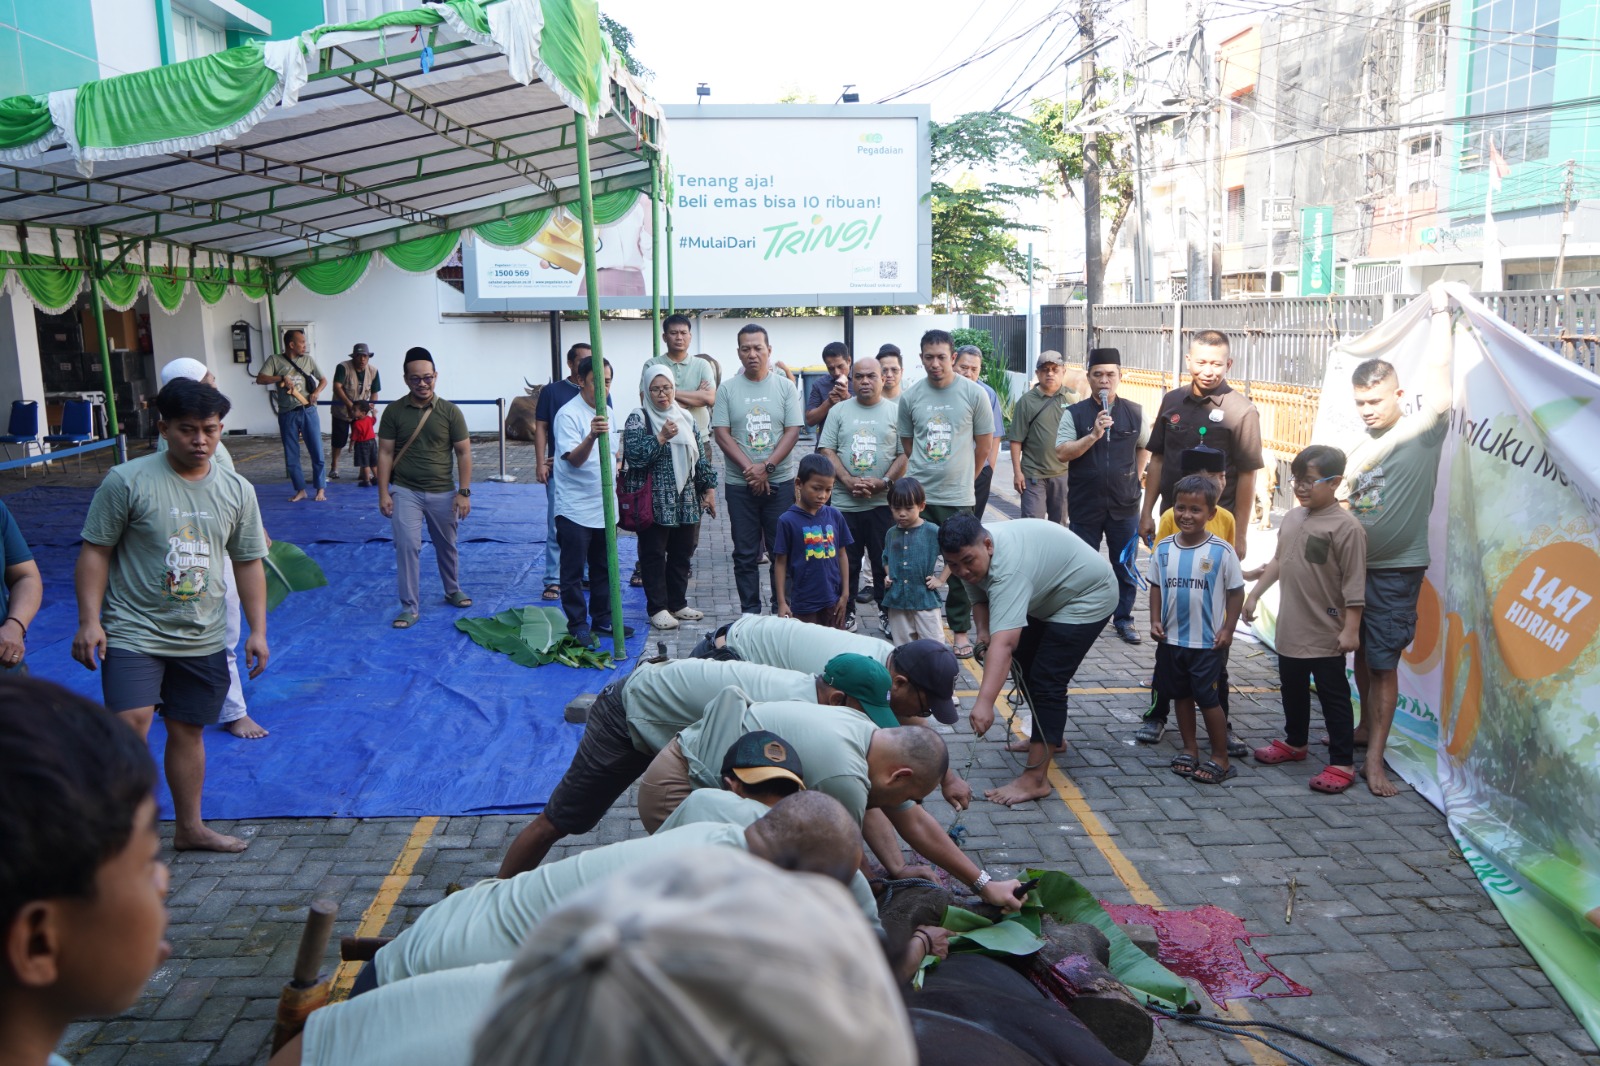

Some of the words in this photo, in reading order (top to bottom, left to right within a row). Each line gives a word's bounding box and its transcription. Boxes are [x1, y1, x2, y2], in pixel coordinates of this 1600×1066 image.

[857, 145, 904, 155] Pegadaian
[677, 174, 738, 193] Tenang
[744, 174, 775, 191] aja!
[678, 195, 707, 208] Beli
[713, 197, 757, 208] emas
[763, 195, 796, 208] bisa
[826, 195, 881, 209] ribuan!
[679, 236, 756, 249] #MulaiDari
[495, 269, 513, 277] 1500
[514, 269, 530, 277] 569
[168, 536, 210, 556] Panitia
[164, 551, 210, 570] Qurban
[1164, 577, 1209, 591] ARGENTINA
[1520, 566, 1592, 624] 1447
[1504, 600, 1570, 653] HIJRIAH
